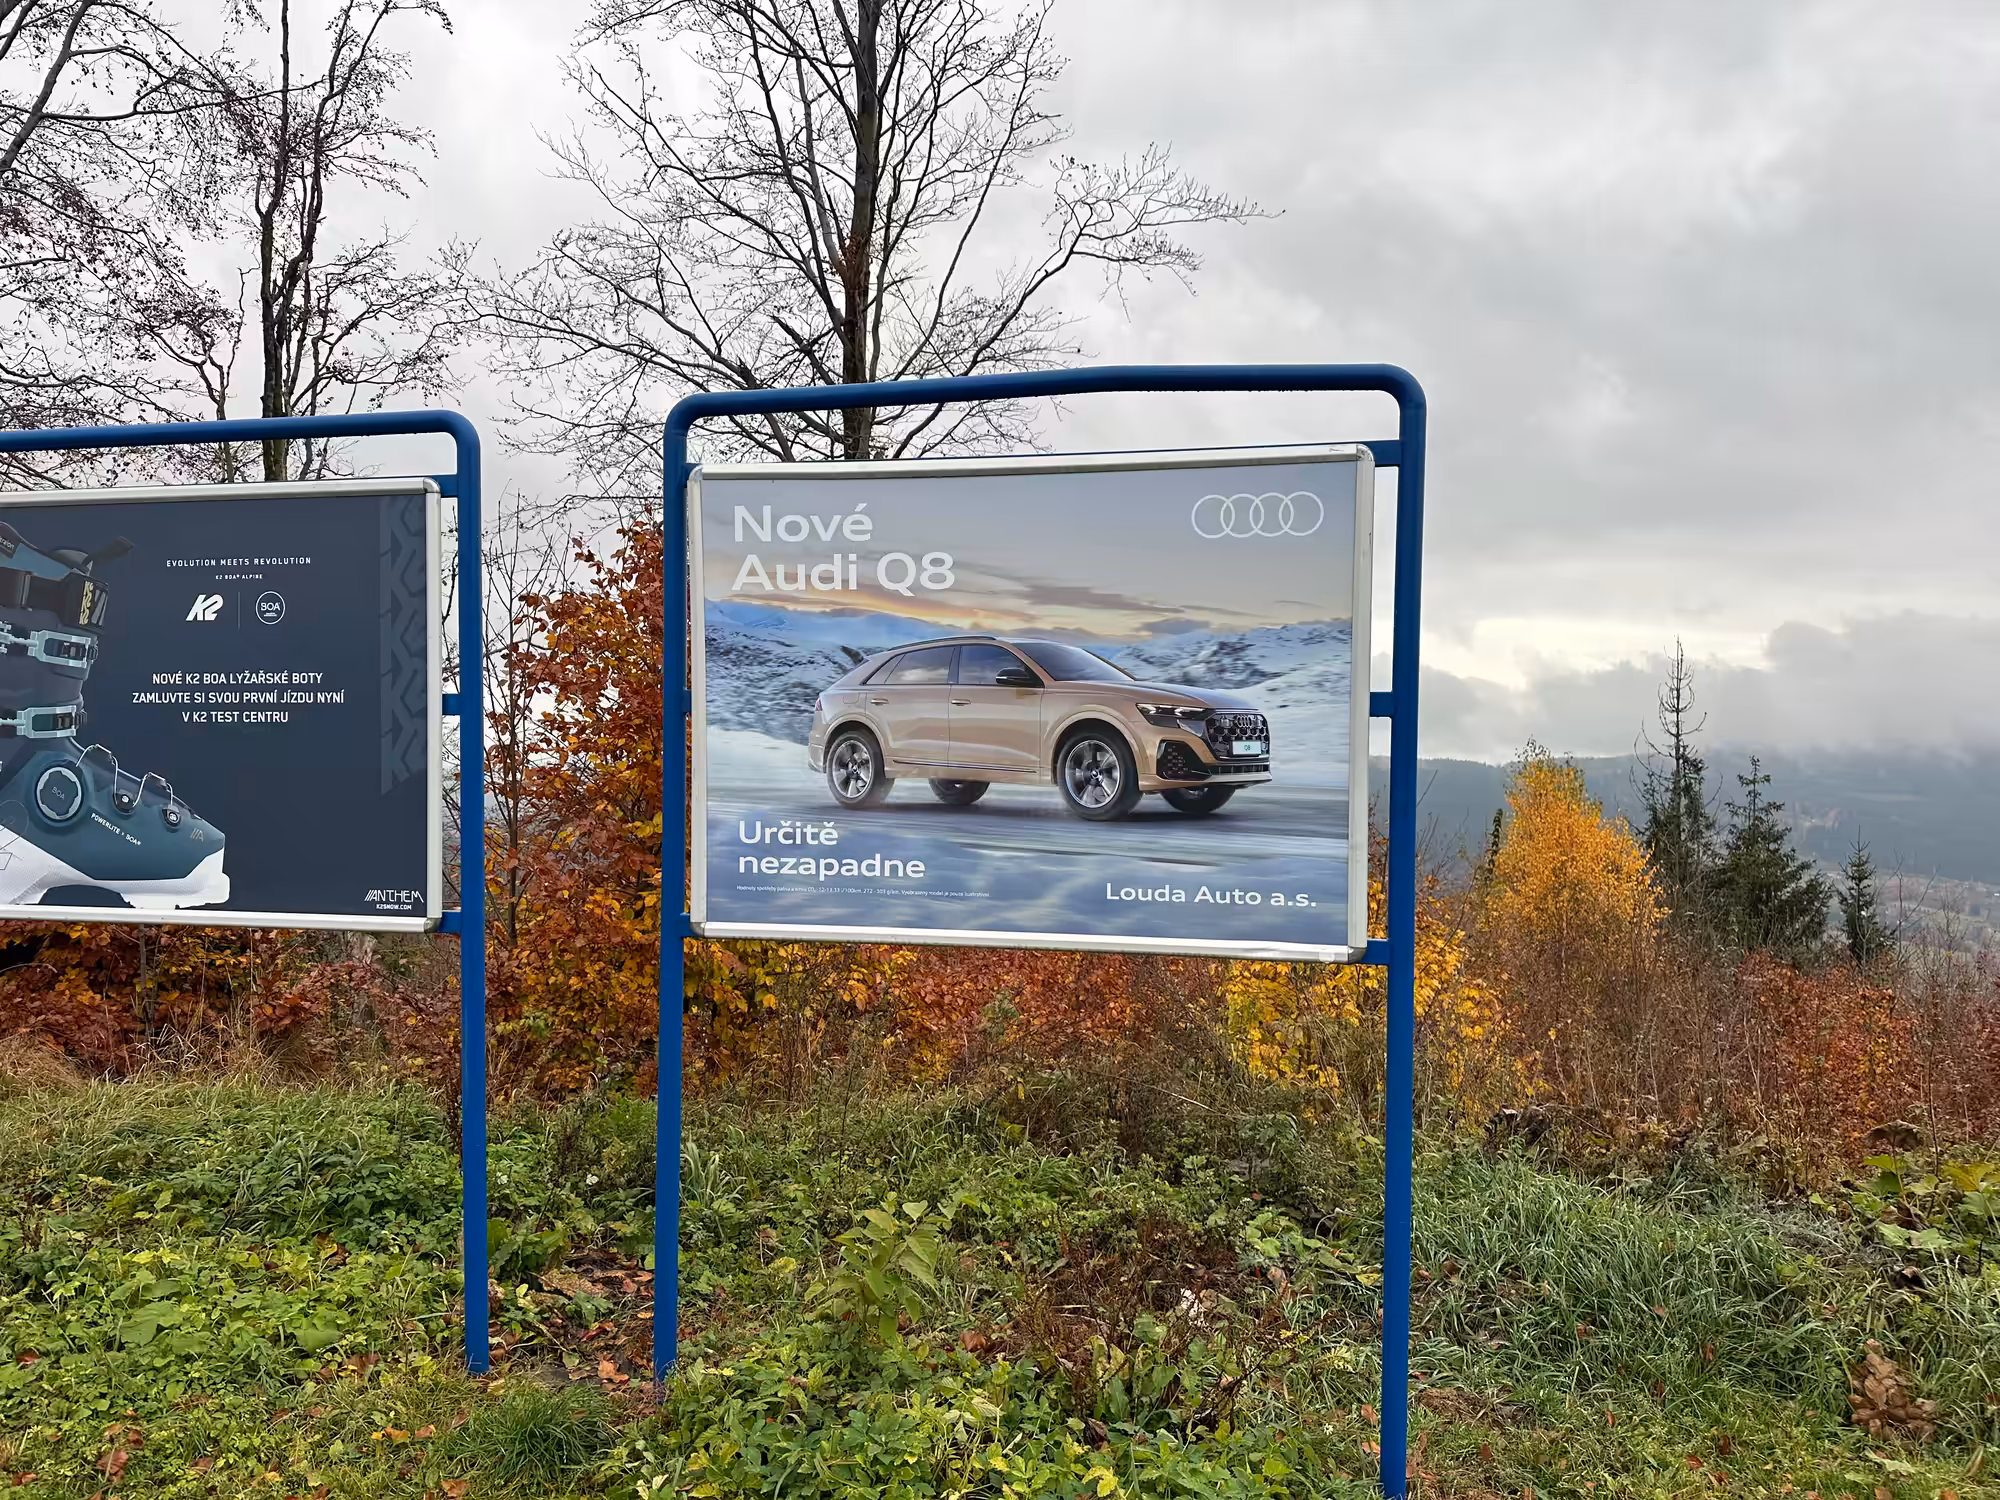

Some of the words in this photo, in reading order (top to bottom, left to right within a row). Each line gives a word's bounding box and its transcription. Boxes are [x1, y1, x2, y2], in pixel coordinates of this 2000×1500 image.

[734, 503, 873, 542] Nové
[166, 558, 216, 567] EVOLUTION
[220, 558, 250, 566] MEETS
[253, 557, 311, 566] REVOLUTION
[732, 553, 857, 591] Audi
[876, 551, 955, 597] Q8
[185, 594, 224, 621] K2
[152, 671, 183, 685] NOVÉ
[185, 673, 200, 685] K2
[203, 673, 227, 685] BOA
[229, 669, 288, 685] LYŽAŘSKÉ
[292, 672, 323, 684] BOTY
[132, 692, 191, 704] ZAMLUVTE
[194, 692, 205, 704] SI
[208, 692, 240, 704] SVOU
[243, 689, 278, 704] PRVNÍ
[280, 689, 314, 704] JÍZDU
[317, 689, 345, 704] NYNÍ
[182, 712, 190, 723] V
[192, 712, 207, 723] K2
[210, 712, 240, 723] TEST
[242, 711, 289, 723] CENTRU
[1243, 744, 1251, 752] Q8
[91, 812, 121, 835] POWERLITE
[739, 820, 839, 845] Určitě
[739, 853, 926, 881] nezapadne
[1106, 882, 1186, 902] Louda
[1194, 885, 1262, 905] Auto
[1270, 892, 1317, 907] a.s.
